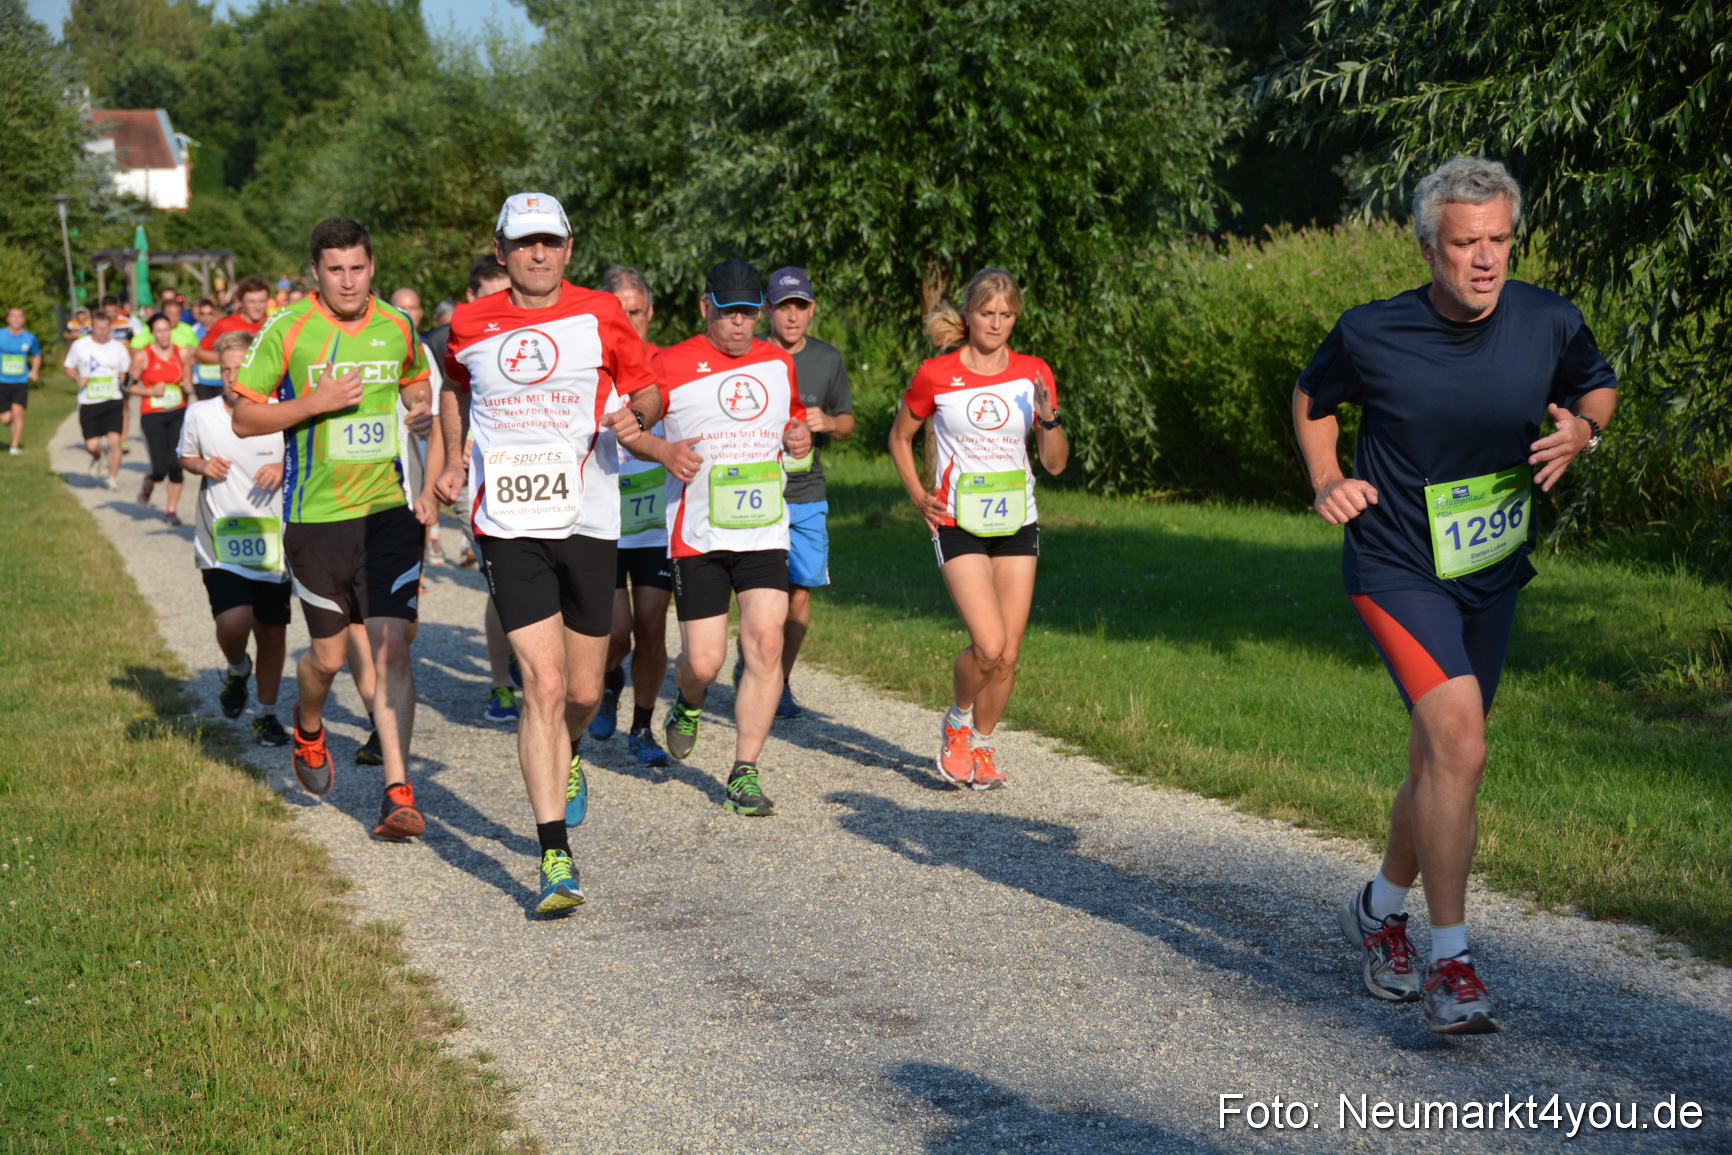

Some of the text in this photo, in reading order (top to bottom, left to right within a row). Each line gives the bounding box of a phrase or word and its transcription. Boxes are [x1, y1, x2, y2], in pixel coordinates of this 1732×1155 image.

[551, 392, 581, 404] HERZ
[504, 408, 524, 416] Heck
[343, 422, 385, 445] 139
[494, 419, 570, 430] Leistungsdiagnostik
[488, 450, 562, 465] df-sports
[496, 472, 570, 504] 8924
[629, 494, 656, 517] 77
[734, 488, 763, 511] 76
[980, 497, 1009, 519] 74
[491, 504, 577, 517] www.df-sports.de
[1444, 499, 1524, 551] 1296
[227, 538, 267, 557] 980
